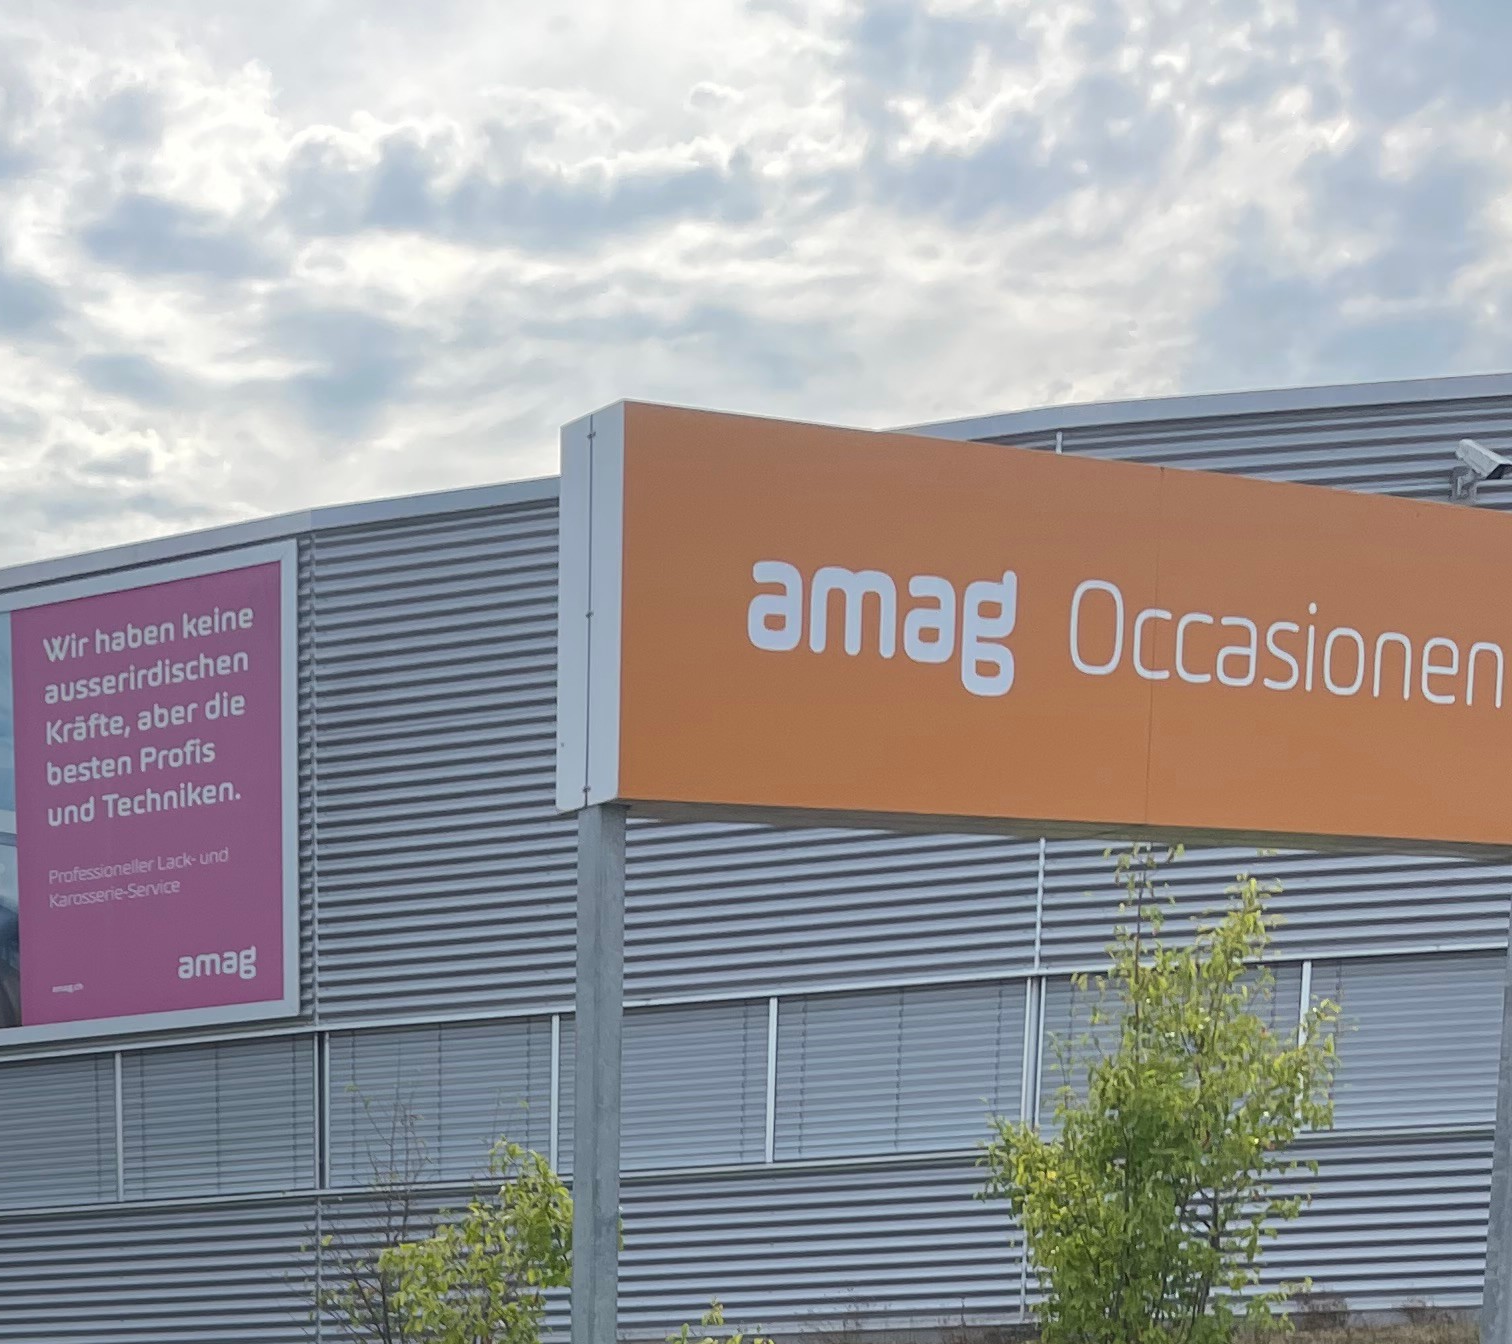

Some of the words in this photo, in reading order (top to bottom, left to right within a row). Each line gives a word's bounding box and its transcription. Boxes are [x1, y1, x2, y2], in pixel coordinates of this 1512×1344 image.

[43, 632, 89, 662] Wir
[95, 623, 175, 654] haben
[183, 606, 254, 638] keine
[748, 560, 1017, 696] amag
[1070, 579, 1504, 709] Occasionen
[44, 651, 249, 704] ausserirdischen
[46, 713, 131, 745] Kräfte,
[138, 703, 199, 731] aber
[205, 691, 246, 720] die
[47, 755, 132, 785] besten
[140, 738, 216, 772] Profis
[48, 796, 95, 826] und
[102, 781, 241, 818] Techniken.
[48, 859, 155, 884] Professioneller
[158, 854, 196, 871] Lack-
[200, 847, 229, 865] und
[49, 879, 181, 908] Karosserie-Service
[178, 945, 257, 980] amag
